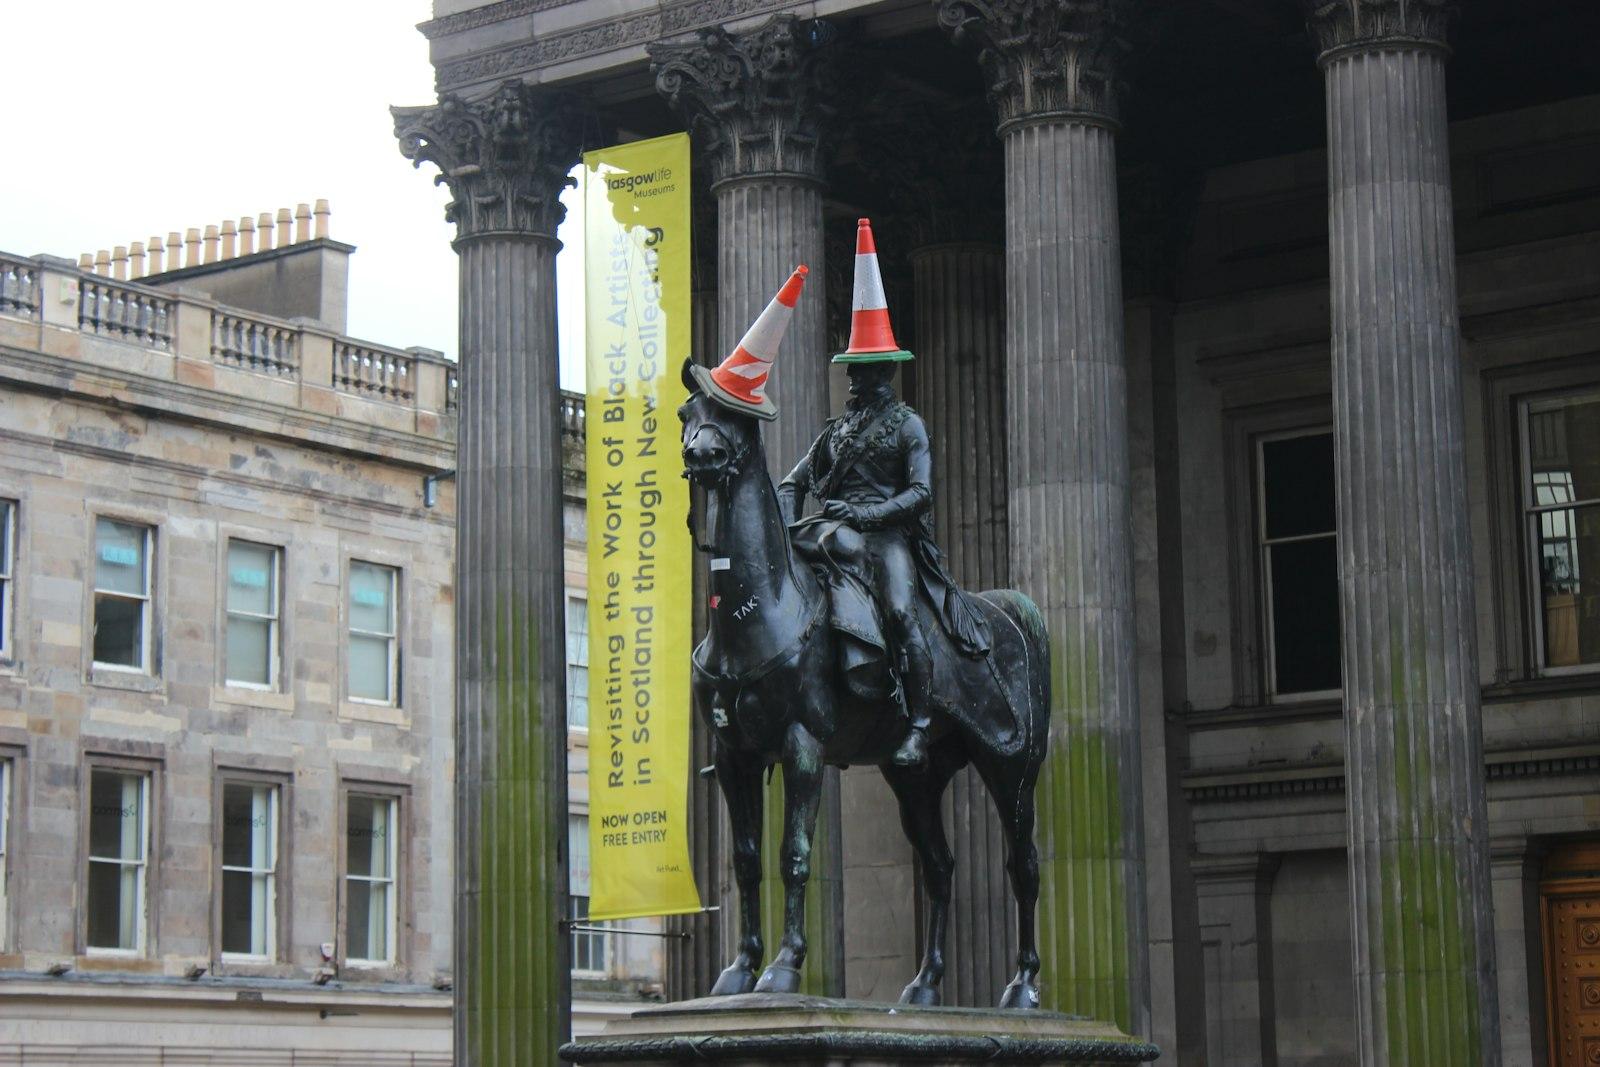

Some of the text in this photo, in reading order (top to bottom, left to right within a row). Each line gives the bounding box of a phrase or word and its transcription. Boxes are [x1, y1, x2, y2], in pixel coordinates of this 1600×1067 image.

[607, 167, 672, 192] lasgowlife
[634, 184, 675, 199] Museums
[602, 232, 629, 787] Revisiting the Work of Black Artists
[631, 227, 664, 786] in Scotland through New Collecting
[602, 811, 667, 828] NOW OPEN
[603, 830, 667, 847] FREE ENTRY
